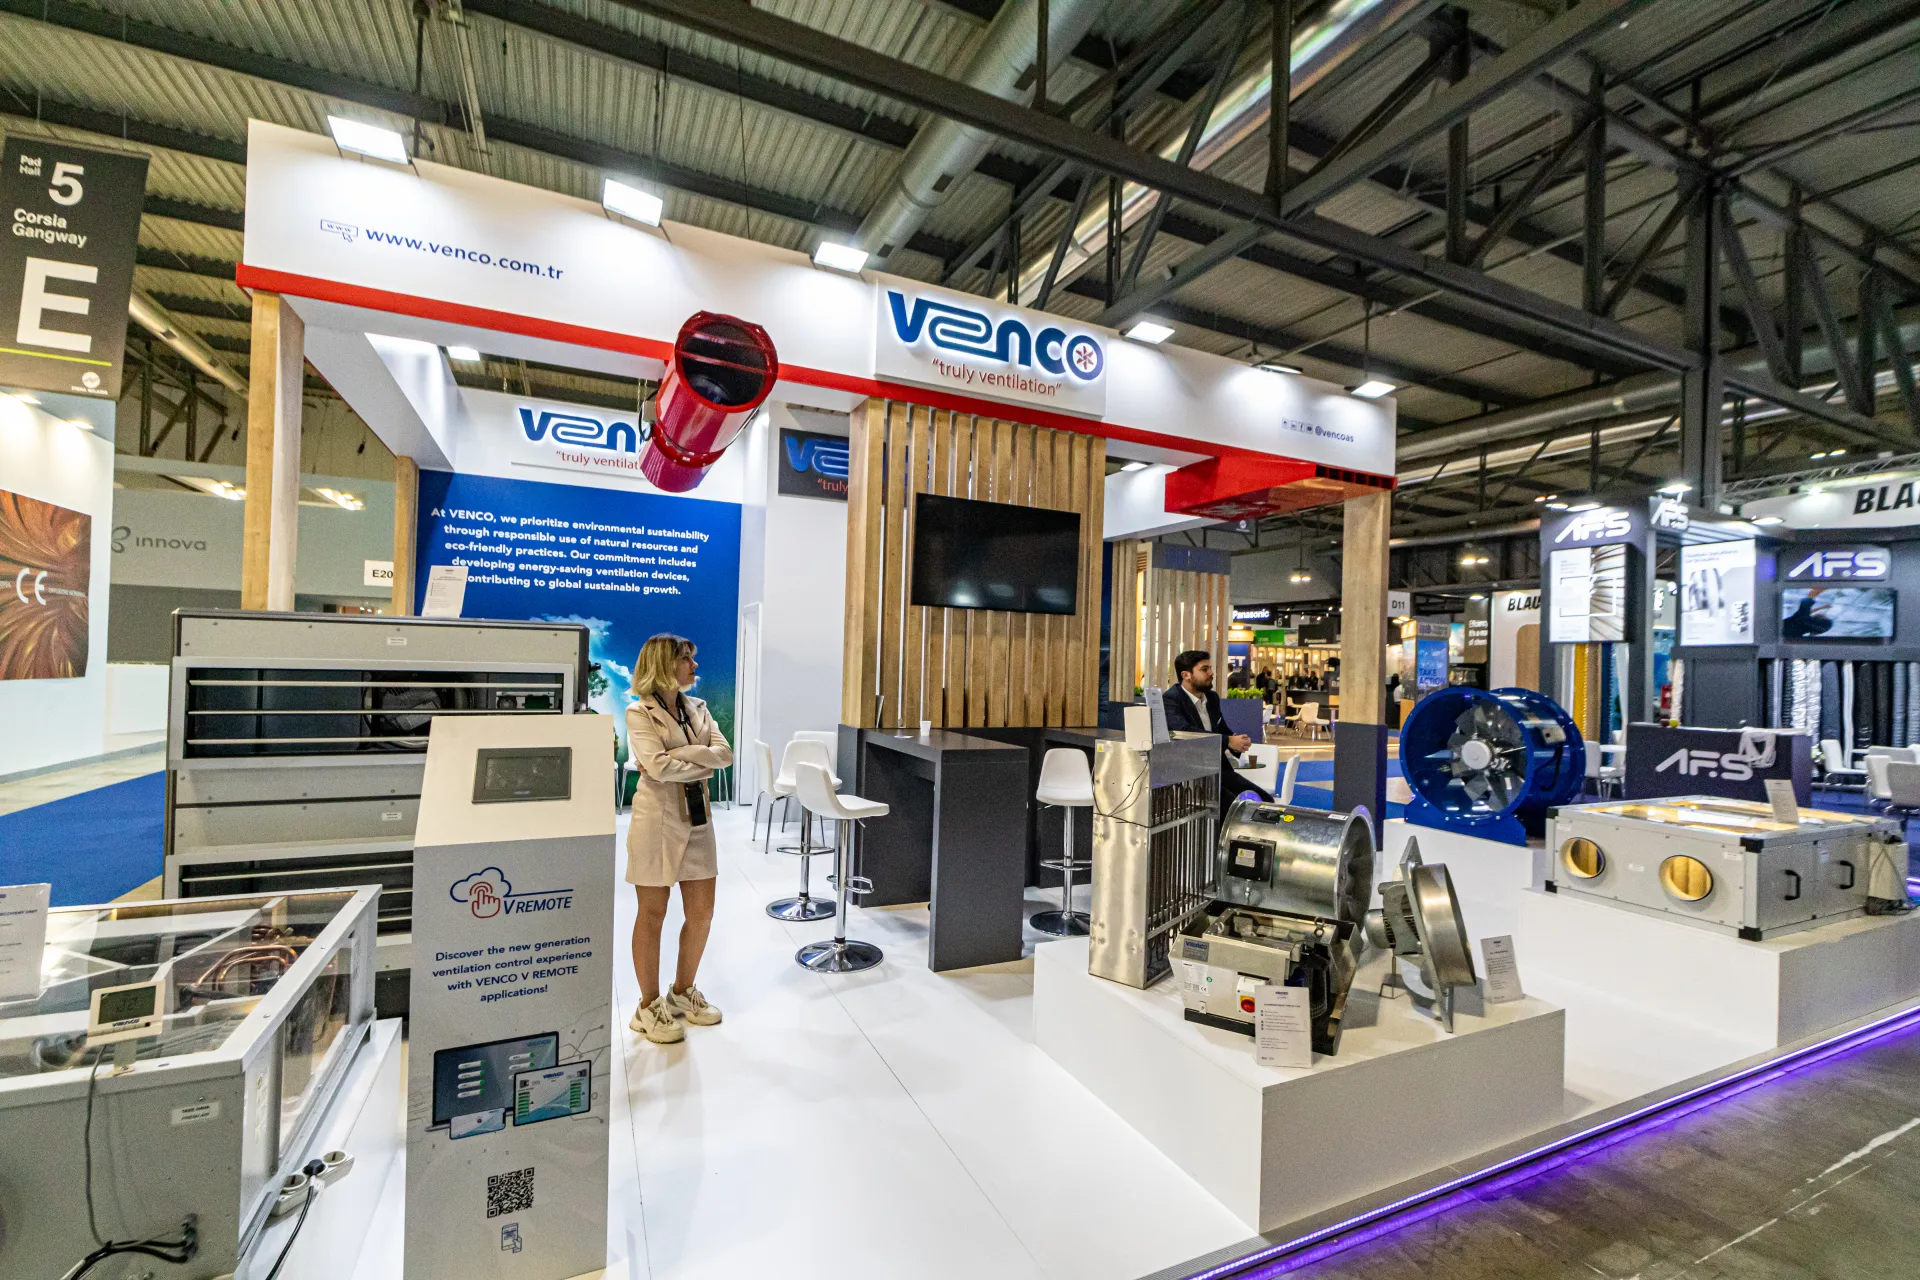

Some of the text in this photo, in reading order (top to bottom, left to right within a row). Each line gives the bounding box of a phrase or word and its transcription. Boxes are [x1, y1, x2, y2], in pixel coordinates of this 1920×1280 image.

[19, 163, 41, 177] Hall
[20, 154, 42, 167] Pad
[48, 161, 85, 206] 5
[13, 207, 67, 229] Corsia
[12, 222, 88, 249] Gangway
[365, 228, 564, 280] www.venco.com.tr
[16, 256, 99, 353] E
[1314, 425, 1355, 442] @vencoas
[594, 456, 639, 470] ventilat
[1853, 481, 1920, 515] BLA
[431, 507, 710, 542] At VENCO, we prioritize environmental sustainability
[135, 536, 207, 551] innova
[444, 524, 698, 553] through responsible use of natural resources and
[445, 541, 697, 568] eco-friendly practices. Our commitment includes
[452, 556, 690, 582] developing energy-saving ventilation devices,
[466, 574, 681, 595] ontributing to global sustainable growth.
[1232, 608, 1270, 619] Panasonic
[1391, 600, 1405, 610] D11
[1418, 677, 1447, 686] ACTION
[1419, 668, 1437, 677] TAKE
[503, 896, 573, 915] V REMOTE
[435, 936, 591, 962] Discover the new generation
[432, 950, 593, 977] ventilation control experience
[447, 965, 579, 991] with VENCO V REMOTE
[480, 984, 548, 1003] applications!
